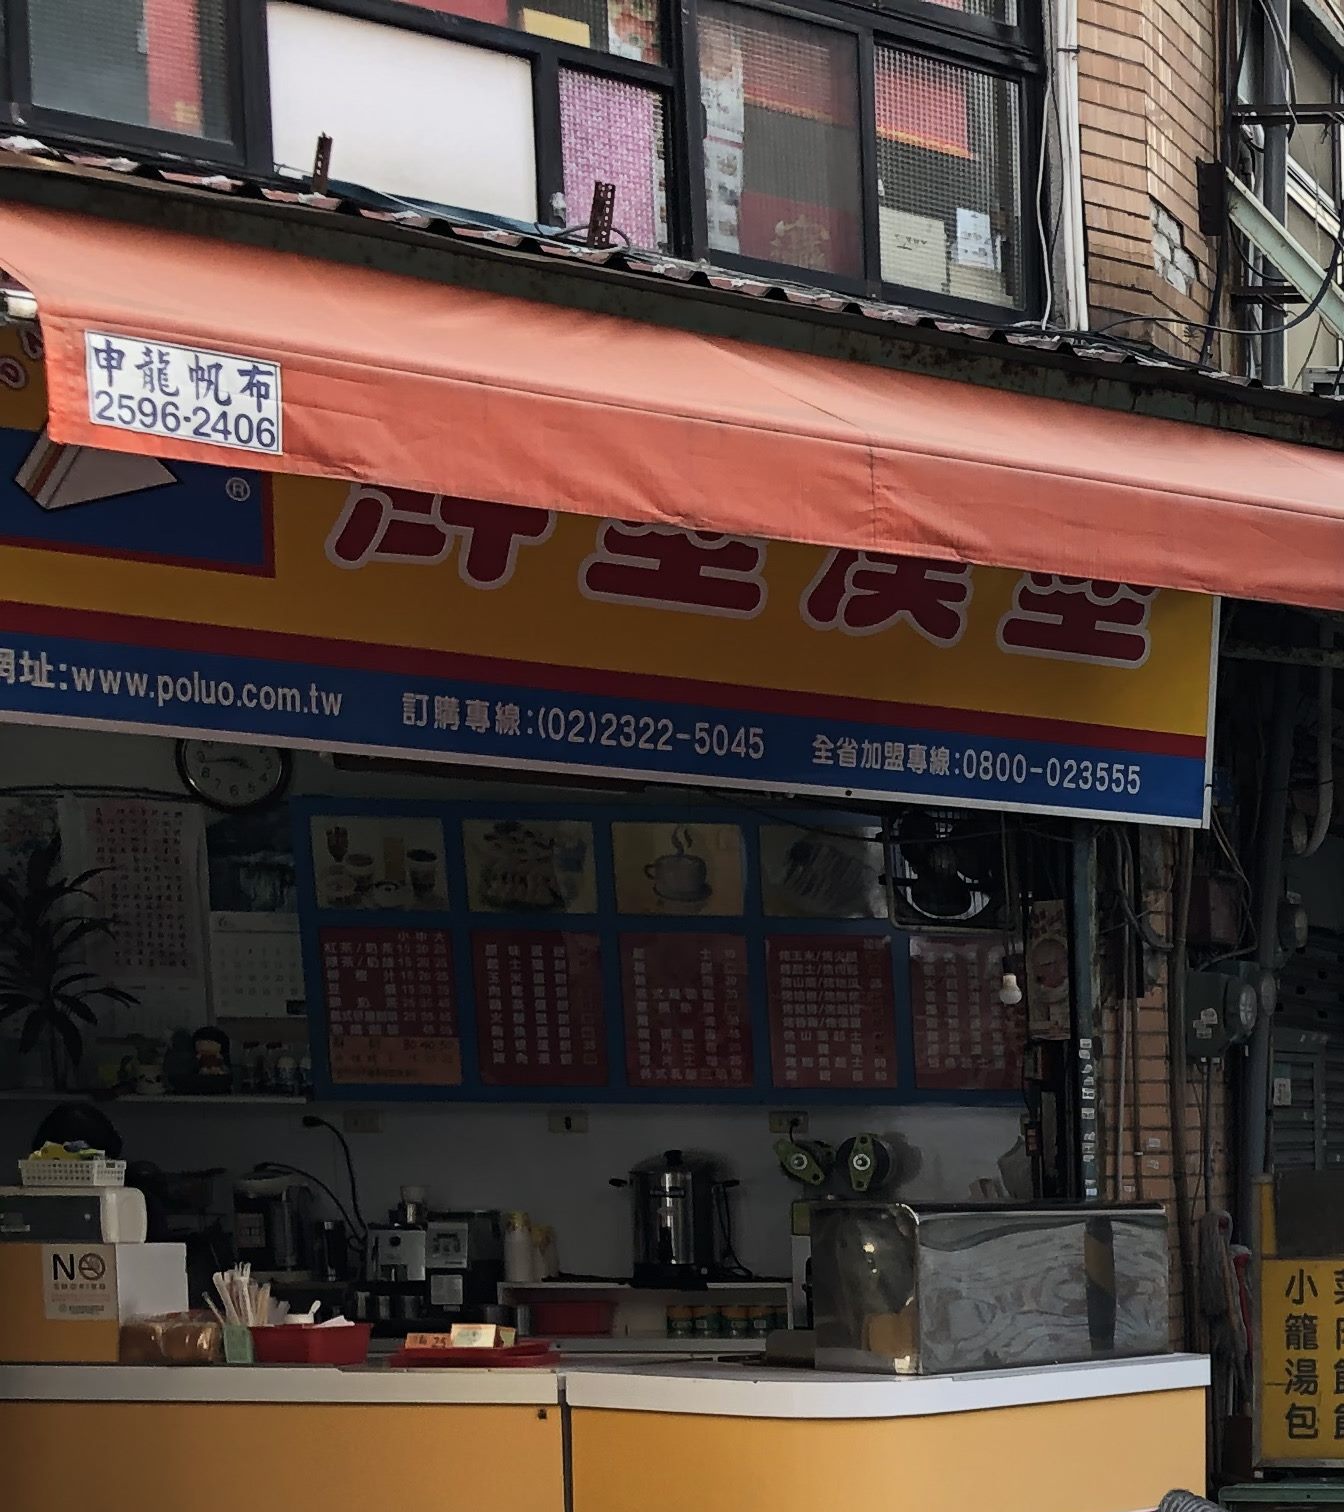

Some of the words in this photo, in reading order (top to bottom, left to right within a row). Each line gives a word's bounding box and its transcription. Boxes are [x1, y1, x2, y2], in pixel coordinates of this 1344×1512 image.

[93, 338, 273, 413] 申龍帆布
[1284, 1268, 1320, 1441] 小籠湯包
